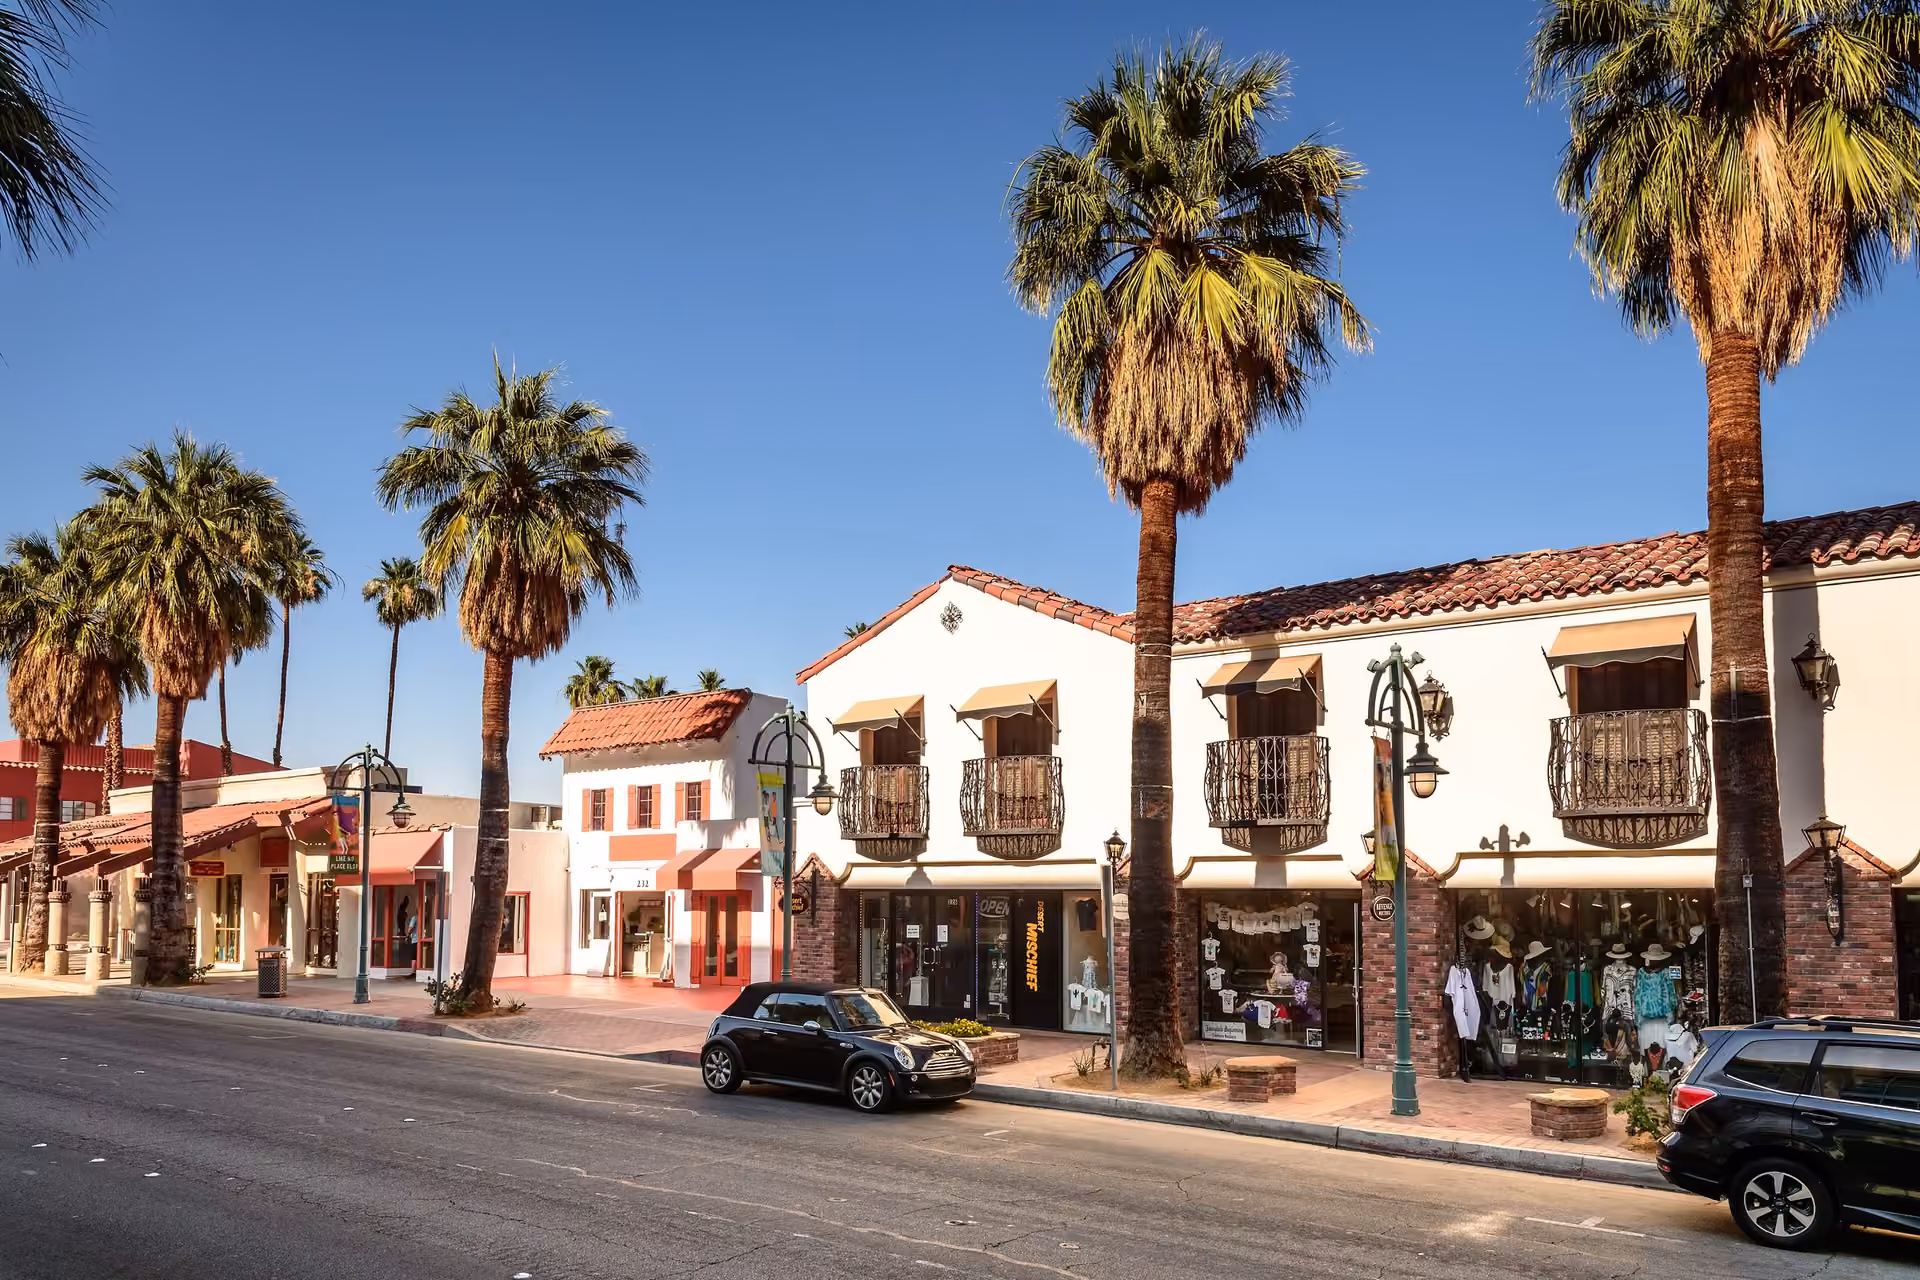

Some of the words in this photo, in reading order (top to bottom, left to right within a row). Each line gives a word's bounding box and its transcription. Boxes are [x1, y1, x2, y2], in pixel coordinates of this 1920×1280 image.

[636, 879, 649, 888] 232
[980, 899, 1010, 916] OPEN
[1026, 922, 1038, 992] MISCHIEF
